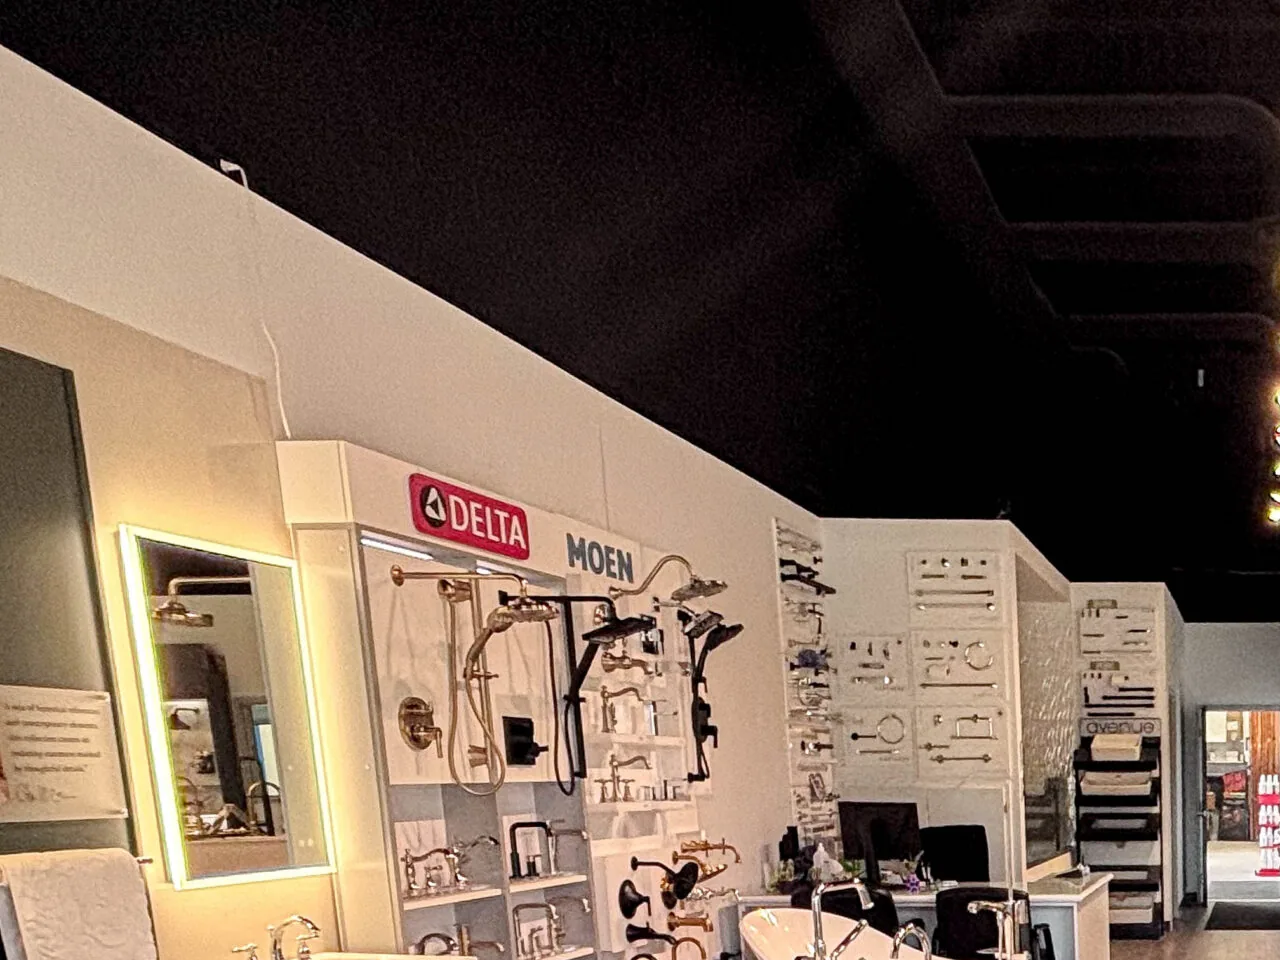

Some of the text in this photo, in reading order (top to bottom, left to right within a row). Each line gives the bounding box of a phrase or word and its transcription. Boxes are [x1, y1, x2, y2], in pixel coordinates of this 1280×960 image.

[448, 494, 527, 550] DELTA
[566, 532, 635, 584] MOEN
[1086, 722, 1155, 735] avenue
